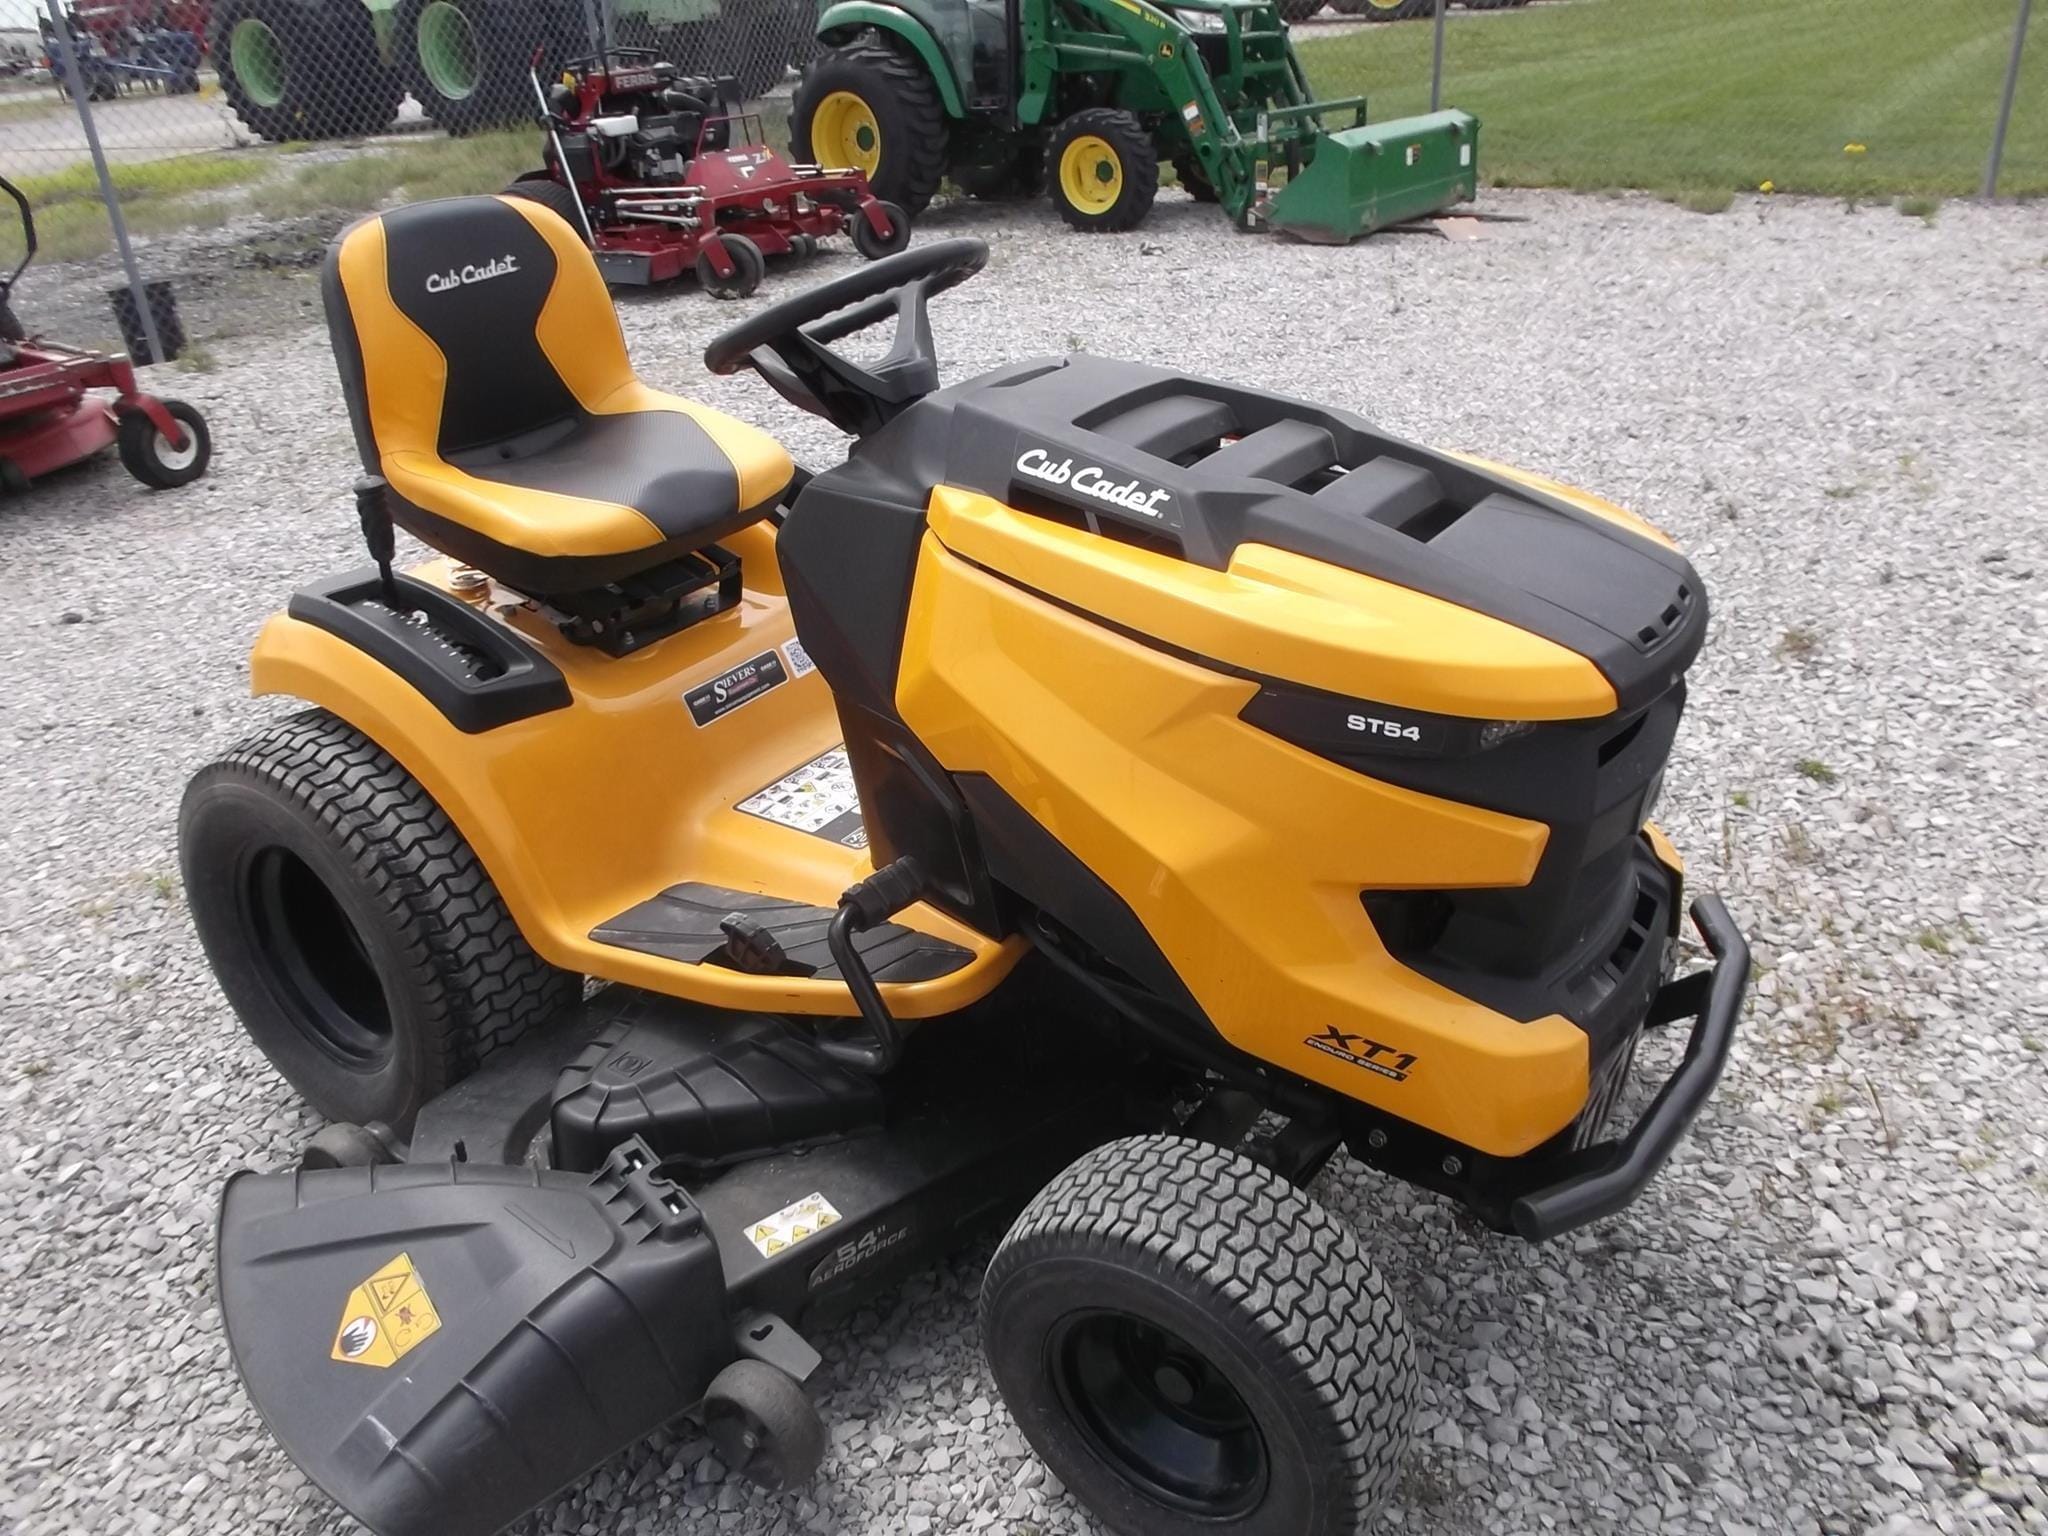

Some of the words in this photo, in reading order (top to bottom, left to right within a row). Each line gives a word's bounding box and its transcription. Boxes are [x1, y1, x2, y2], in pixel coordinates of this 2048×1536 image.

[615, 74, 657, 89] FERRIS
[426, 269, 461, 293] Cub
[461, 254, 521, 284] Cadet
[1016, 449, 1073, 484] Cub
[1070, 467, 1171, 517] Cadet
[713, 663, 757, 704] SIEVERS
[1347, 714, 1420, 742] ST54
[1306, 1038, 1355, 1061] ENDURO
[1356, 1058, 1399, 1078] SERIES
[1311, 1024, 1418, 1070] XT1
[812, 1227, 908, 1288] AEROFORCE
